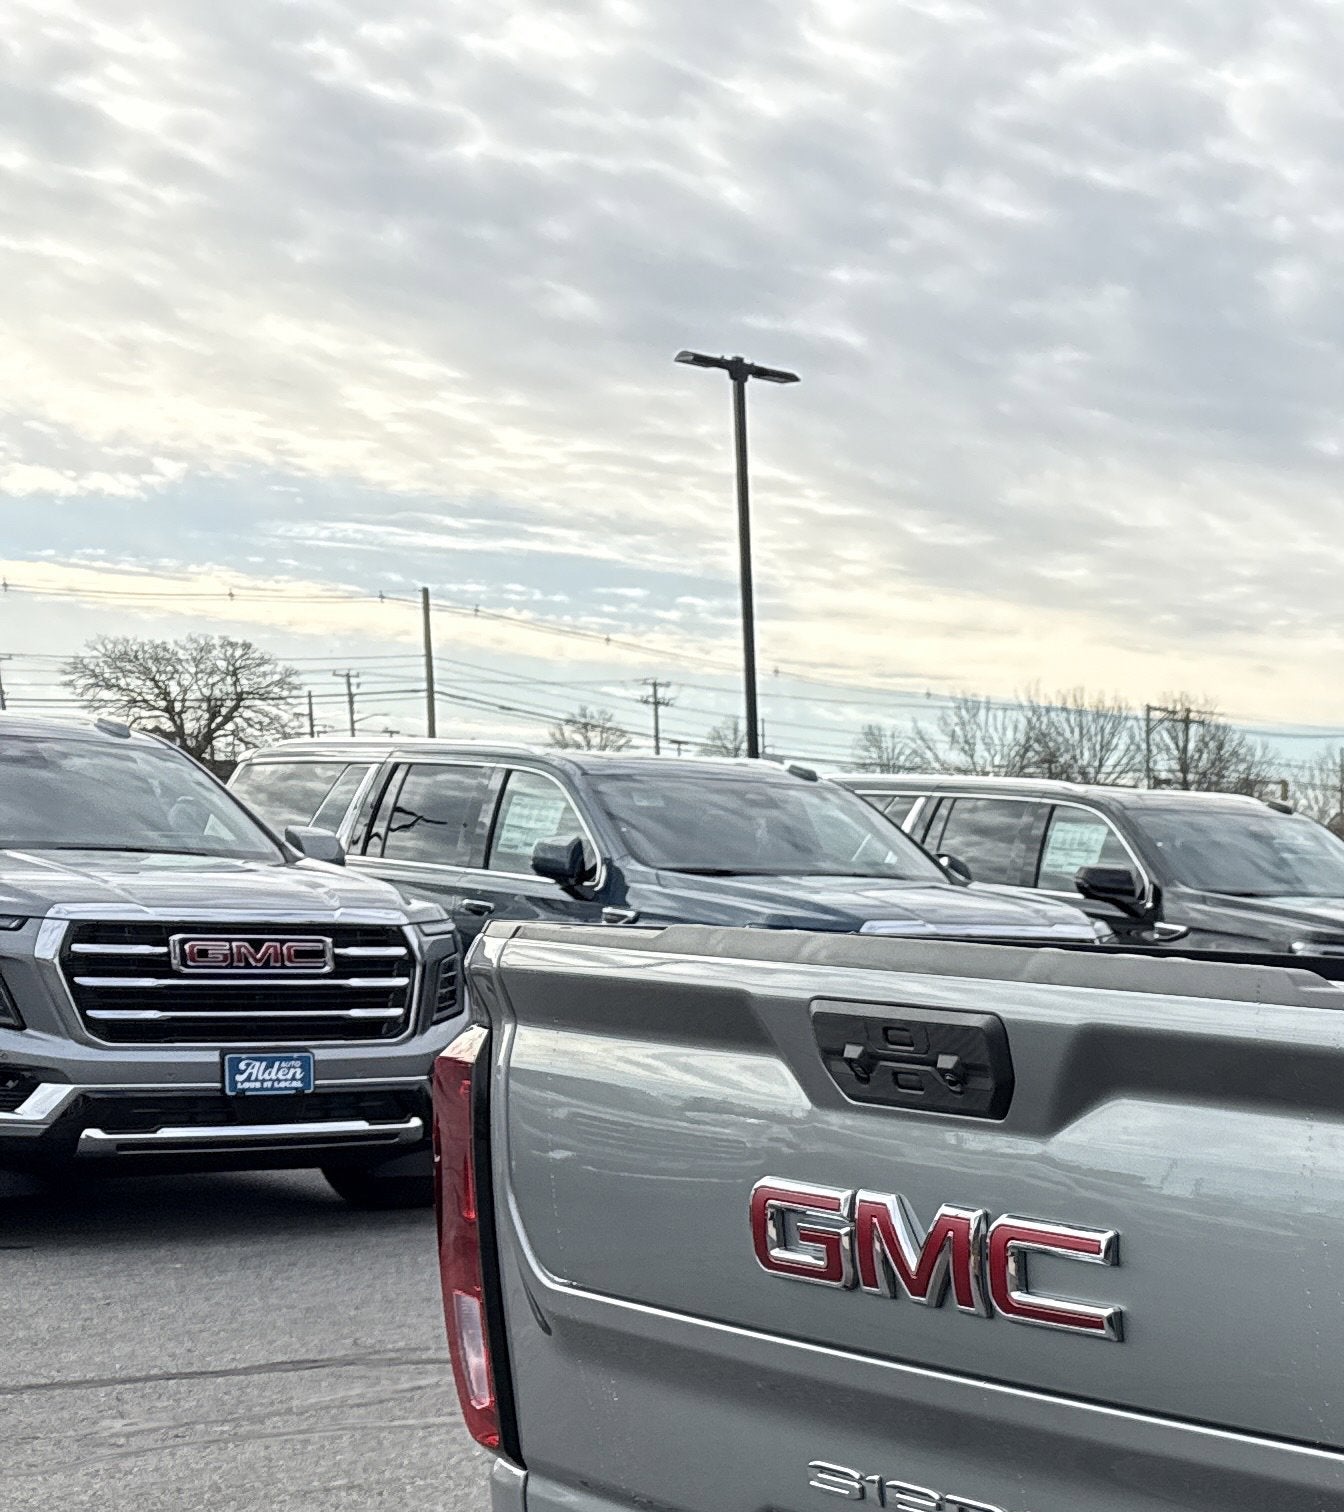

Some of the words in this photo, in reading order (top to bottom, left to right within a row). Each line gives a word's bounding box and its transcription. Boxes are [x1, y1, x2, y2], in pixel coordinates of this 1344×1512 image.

[184, 941, 326, 967] GMC
[235, 1060, 304, 1082] Alden
[749, 1175, 1126, 1342] GMC
